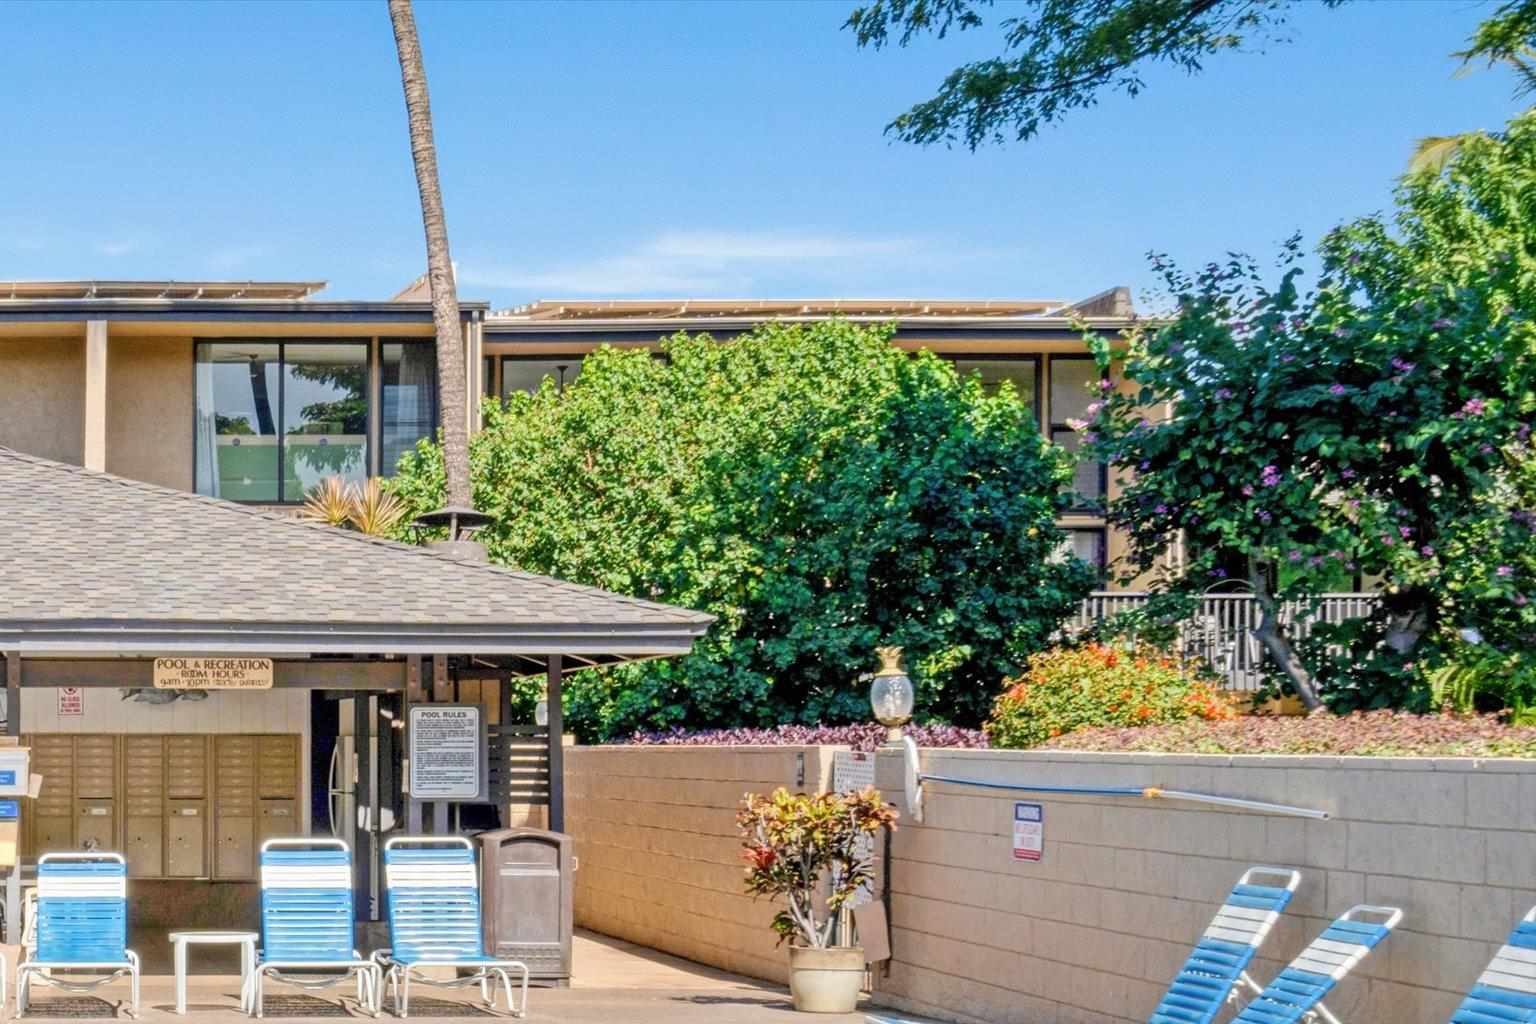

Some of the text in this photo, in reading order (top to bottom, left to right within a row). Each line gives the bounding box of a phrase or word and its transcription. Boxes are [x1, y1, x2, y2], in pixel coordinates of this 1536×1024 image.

[158, 659, 190, 669] POOL
[204, 659, 270, 670] RECREATION
[211, 670, 245, 679] HOURS
